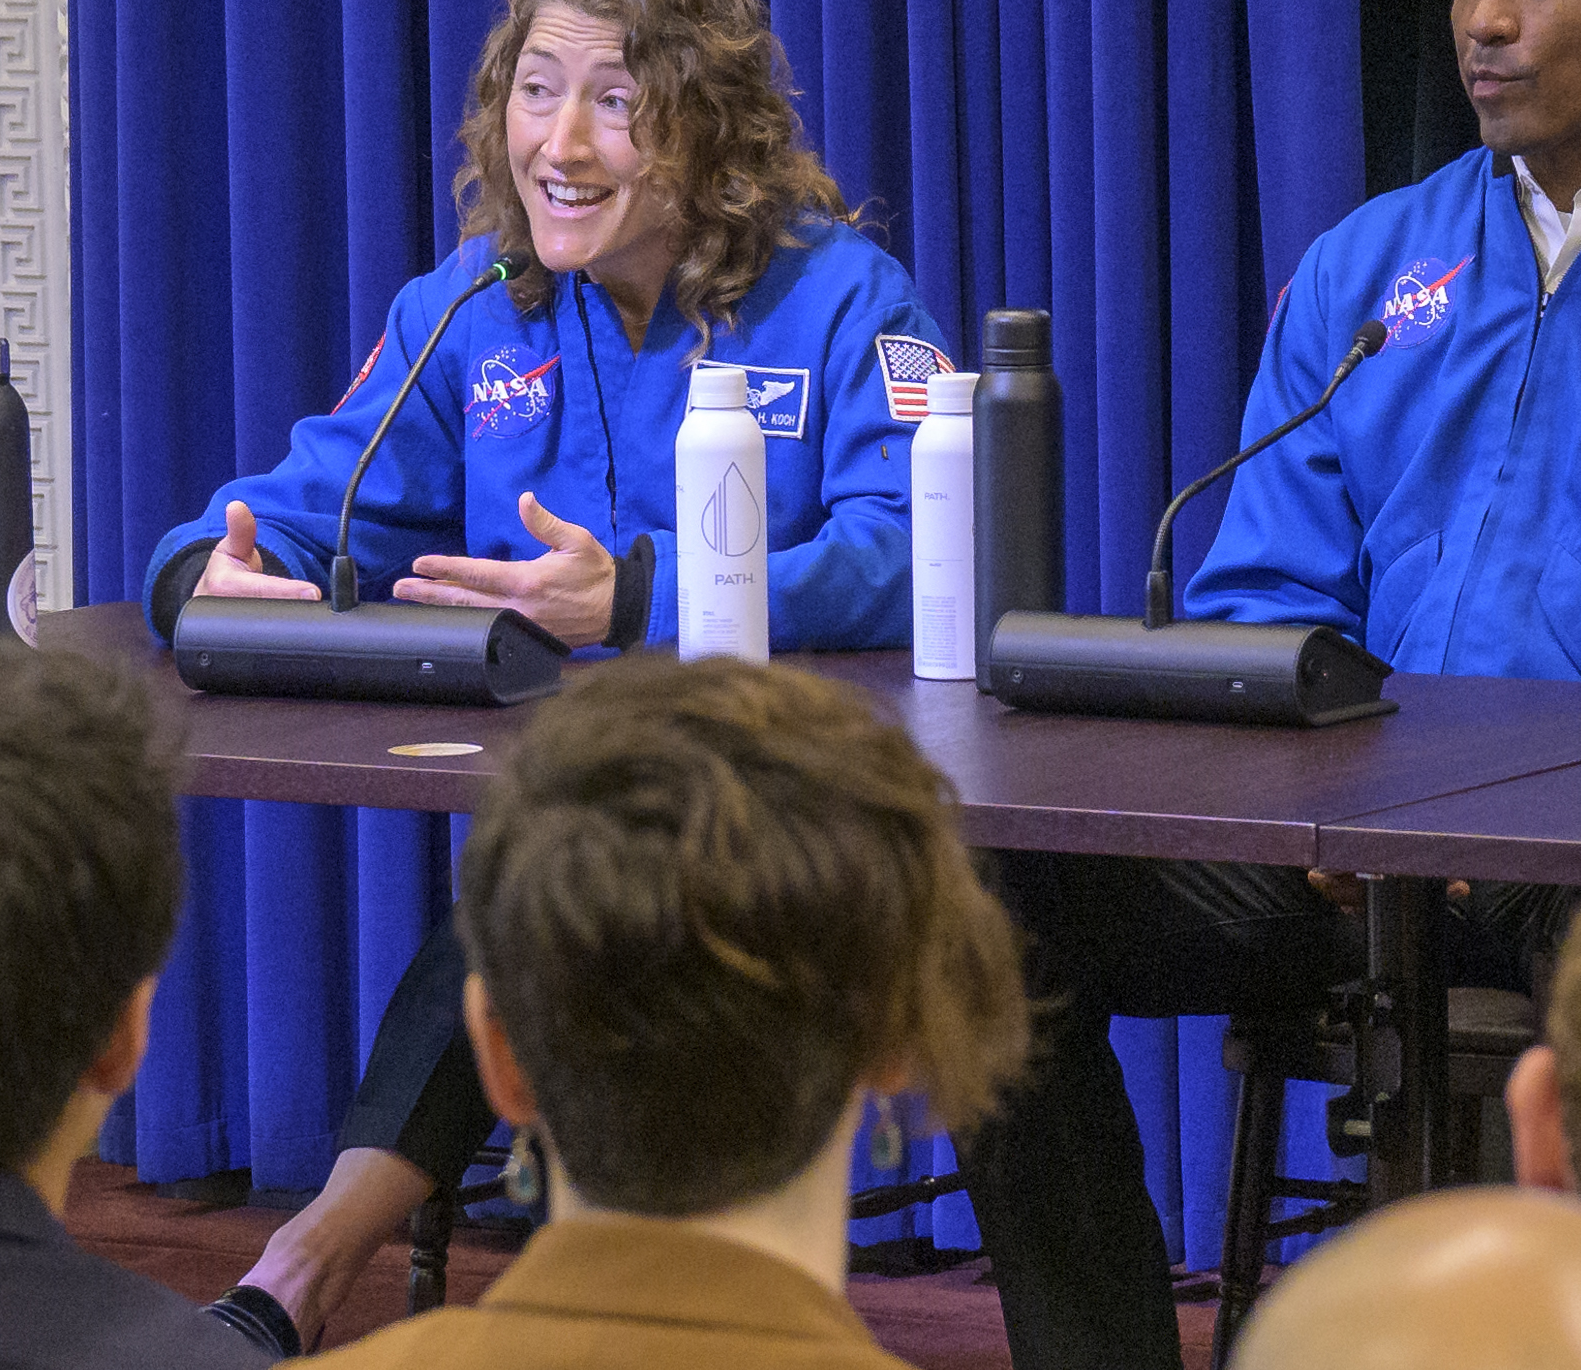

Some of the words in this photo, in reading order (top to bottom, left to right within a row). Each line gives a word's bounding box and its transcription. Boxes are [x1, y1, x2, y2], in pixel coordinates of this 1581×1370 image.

[1383, 285, 1450, 319] NASA
[472, 377, 550, 403] NASA
[771, 413, 796, 426] KOCH
